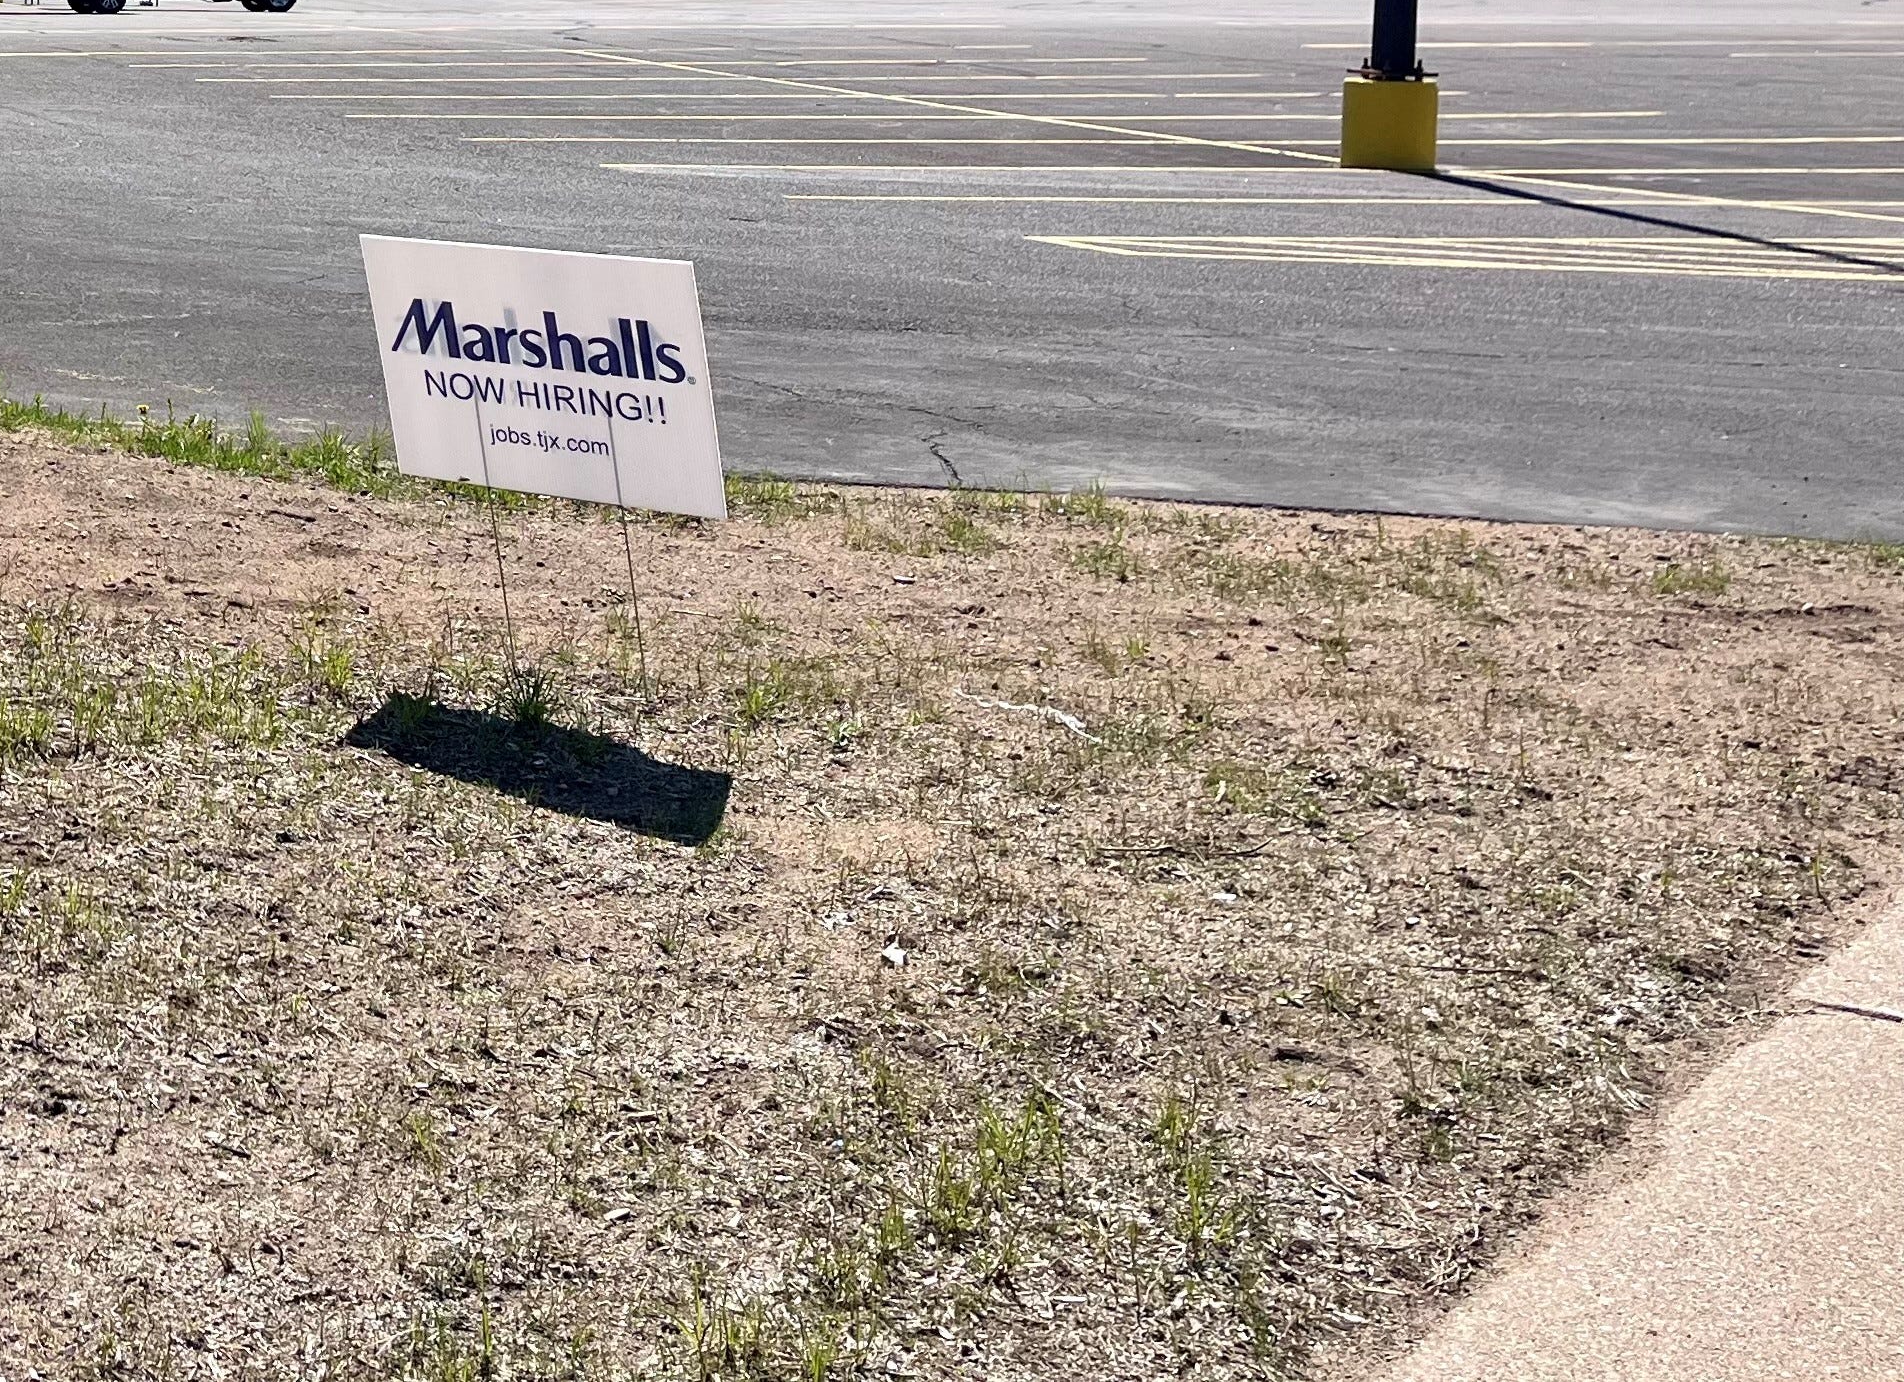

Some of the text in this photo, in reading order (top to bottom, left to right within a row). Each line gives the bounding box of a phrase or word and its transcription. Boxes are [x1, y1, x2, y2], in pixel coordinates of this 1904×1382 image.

[392, 298, 687, 385] Marshalls
[424, 369, 666, 425] NOW HIRING!!
[489, 423, 610, 457] jobs.tjx.com
